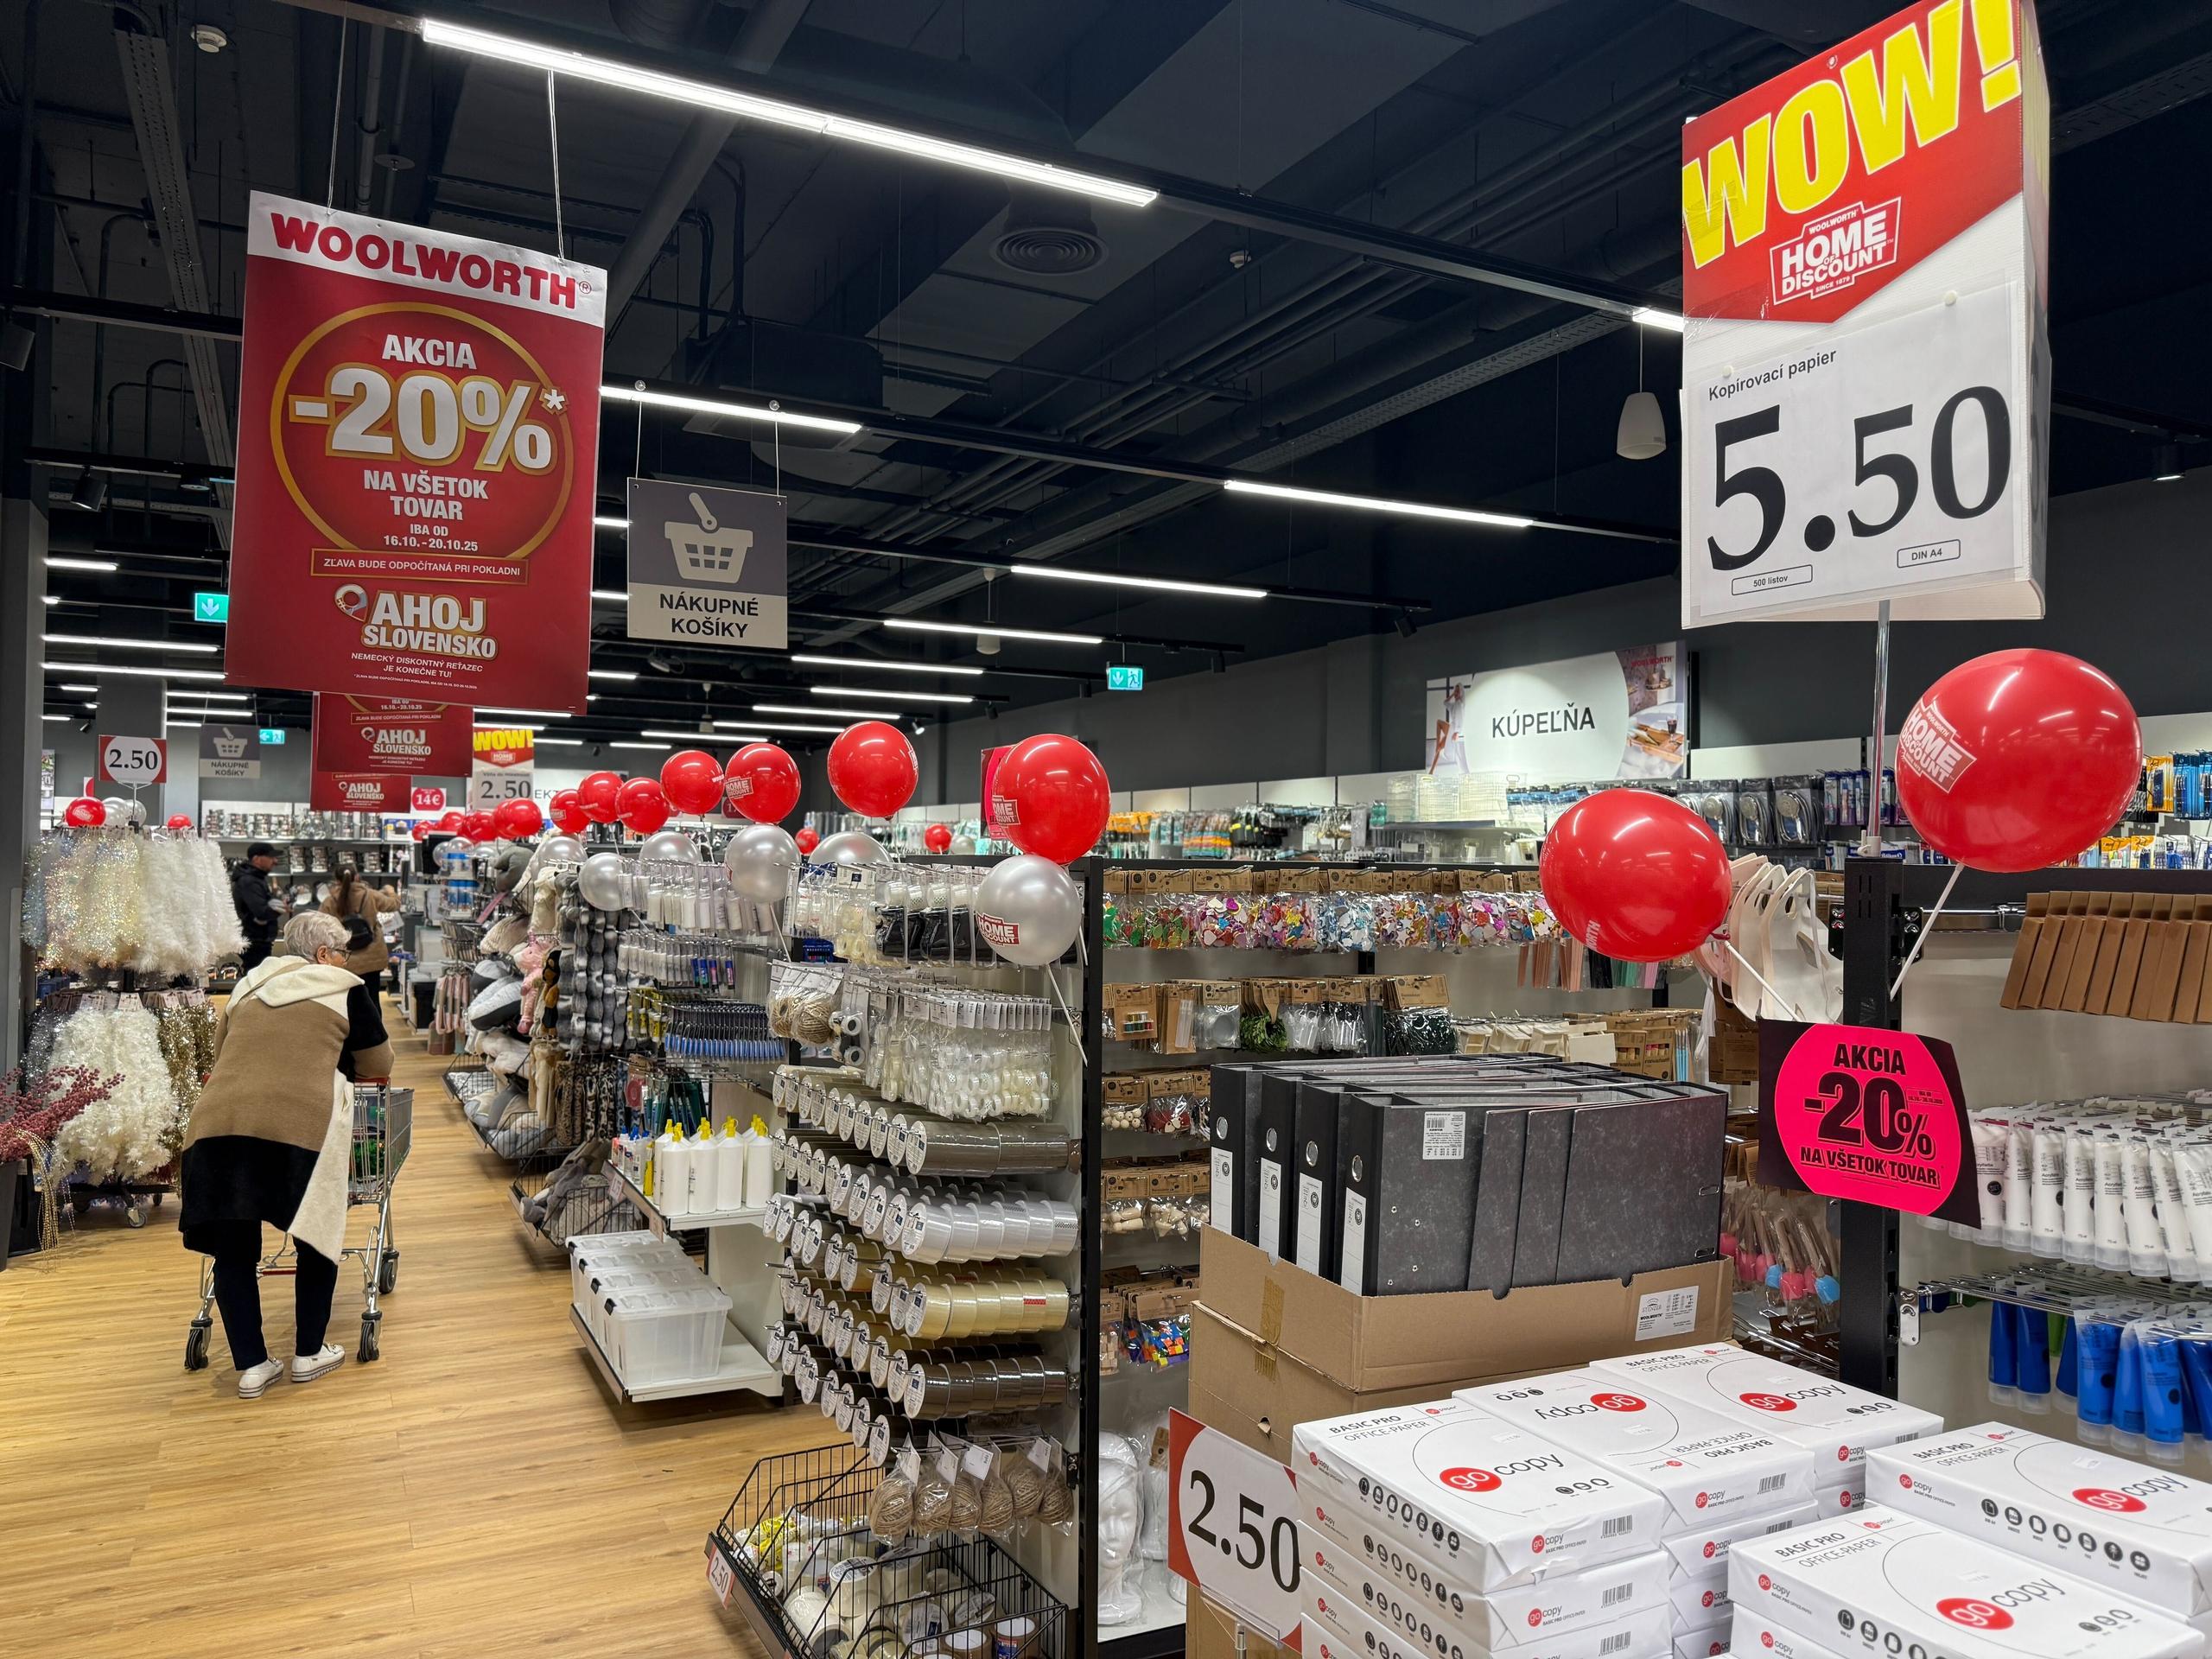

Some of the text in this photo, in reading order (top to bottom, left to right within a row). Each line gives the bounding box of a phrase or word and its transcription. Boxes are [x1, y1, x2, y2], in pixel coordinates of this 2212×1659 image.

[1683, 0, 2022, 269] WOW!
[1782, 210, 1887, 278] HOME
[1782, 241, 1887, 296] DISCOUNT
[1823, 254, 1836, 265] OF
[1815, 276, 1851, 293] SINCE 1879
[382, 334, 477, 370] AKCIA
[1708, 348, 1837, 401] Kopírovací papier
[364, 469, 489, 499] NA VŠETOK
[1707, 385, 2011, 570] 5.50
[390, 496, 463, 520] TOVAR
[410, 524, 448, 537] IBA OD
[1911, 548, 1943, 562] DIN A4
[324, 558, 520, 575] ZĽAVA BUDE ODPOČÍTANÁ PRI POKLADNI
[1752, 574, 1788, 587] 500 listov
[372, 593, 484, 632] AHOJ
[660, 591, 759, 616] NÁKUPNÉ
[671, 617, 748, 638] KOŠÍKY
[364, 626, 496, 658] SLOVENSKO
[351, 652, 483, 671] NEMECKÝ DISKONTNÝ REŤAZEC
[396, 665, 437, 677] KONEČNE
[439, 670, 452, 678] TU!
[1492, 702, 1595, 739] KÚPEĽŇA
[376, 729, 427, 745] AHOJ
[474, 728, 534, 751] WOW!
[1906, 707, 1963, 774] HOME
[108, 748, 159, 770] 2.50
[373, 743, 432, 755] SLOVENSKO
[1901, 727, 1951, 783] DISCOUNT
[211, 760, 250, 769] NÁKUPNÉ
[215, 768, 245, 777] KOŠÍKY
[348, 783, 381, 793] AHOJ
[480, 780, 531, 798] 2.50
[977, 916, 1015, 938] HOME
[1834, 1043, 1906, 1076] AKCIA
[1804, 1071, 1935, 1159] -20%
[1801, 1147, 1940, 1187] NA VŠETOK TOVAR
[1625, 1357, 1662, 1367] BASIC
[1642, 1358, 1714, 1372] OFFICE-PAPER
[1750, 1383, 1847, 1409] go copy
[1534, 1395, 1637, 1420] go copy
[1329, 1415, 1402, 1434] BASIC PRO
[1344, 1421, 1429, 1442] OFFICE-PAPER
[1671, 1432, 1753, 1452] OFFICE-PAPER
[1704, 1440, 1774, 1458] BASIC PRO
[1839, 1446, 1865, 1459] go copy
[1912, 1442, 1975, 1459] BASIC PRO
[1936, 1446, 2010, 1466] OFFICE-PAPER
[1449, 1453, 1565, 1489] go copy
[1913, 1481, 1932, 1493] copy
[2087, 1475, 2189, 1510] go copy
[1697, 1491, 1726, 1506] go copy
[1840, 1492, 1866, 1504] go copy
[1188, 1469, 1300, 1593] 2.50
[1532, 1534, 1564, 1551] go copy
[1705, 1539, 1732, 1555] go copy
[1774, 1532, 1846, 1557] BASIC PRO
[1798, 1538, 1882, 1567] OFFICE-PAPER
[711, 1556, 728, 1594] 2.50
[1703, 1590, 1727, 1605] go cop
[1759, 1577, 1790, 1598] go copy
[1950, 1578, 2065, 1626] go copy
[1529, 1605, 1562, 1624] go copy
[1762, 1634, 1793, 1655] go copy
